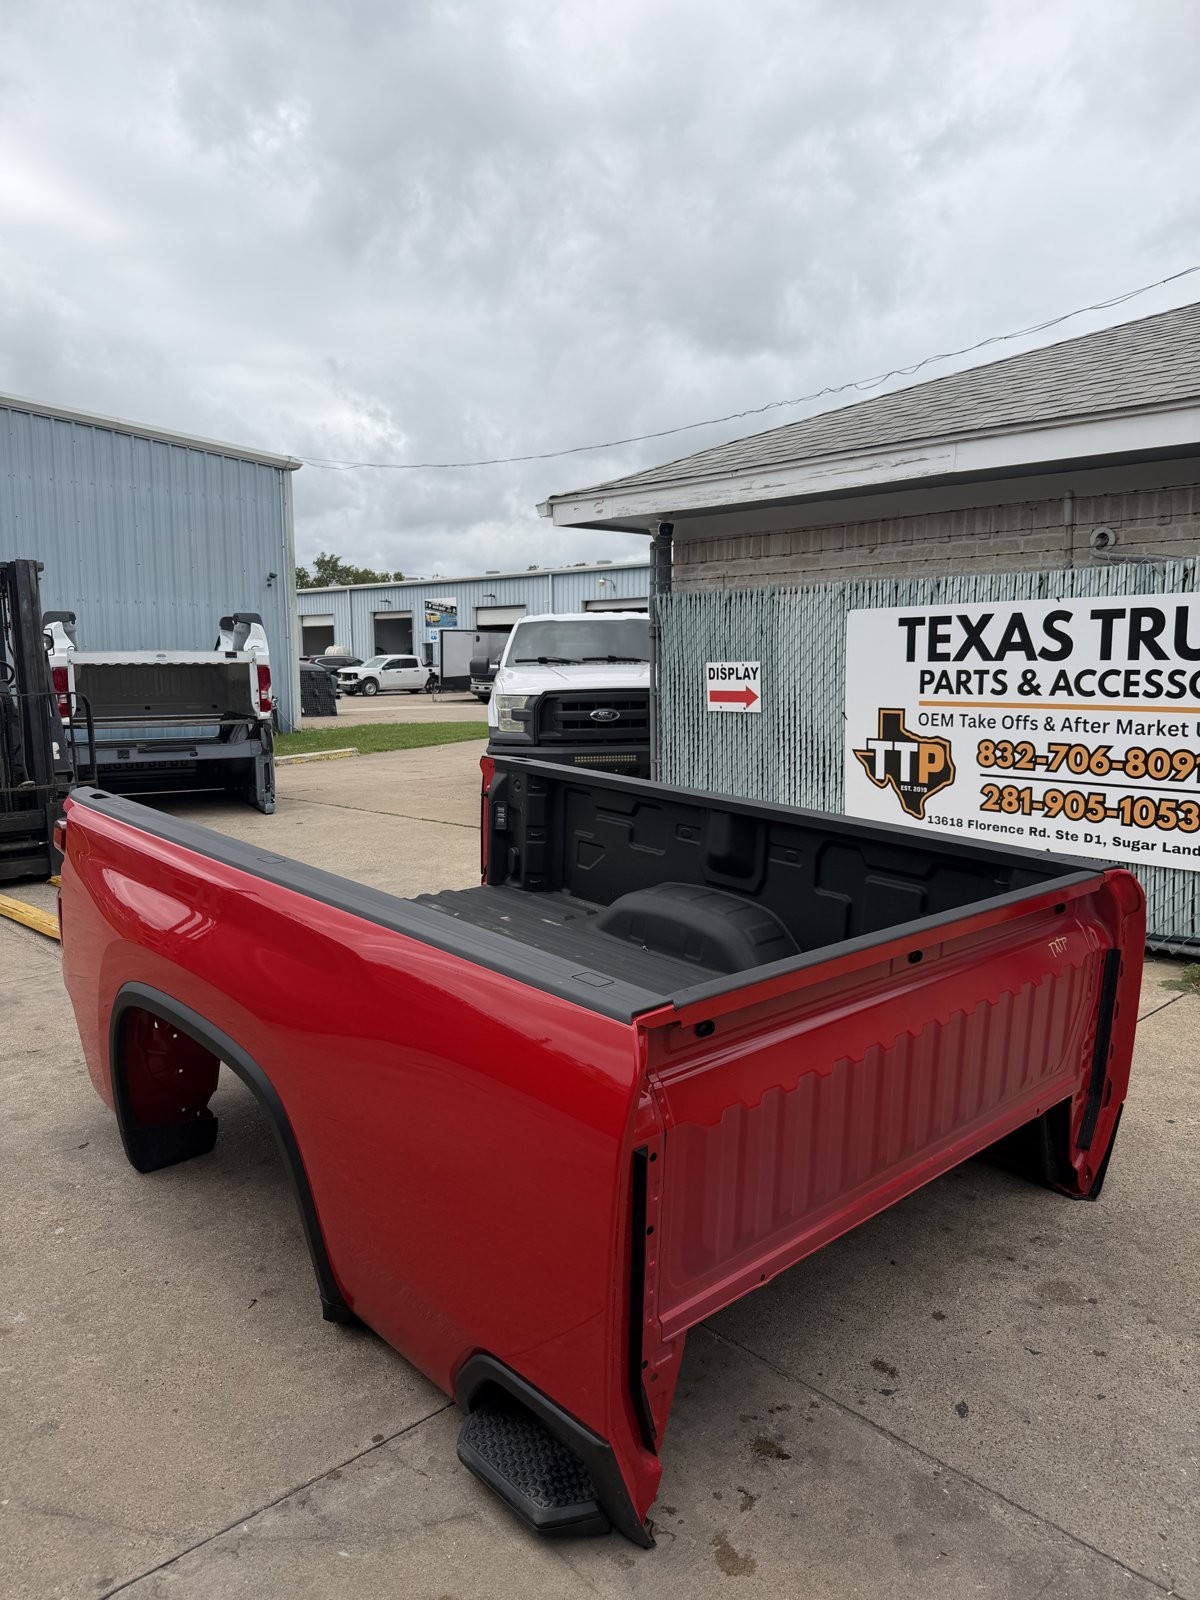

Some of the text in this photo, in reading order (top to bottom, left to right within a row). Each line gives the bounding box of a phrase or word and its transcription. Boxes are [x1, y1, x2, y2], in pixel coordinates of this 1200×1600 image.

[898, 605, 1200, 662] TEXAS TRU
[708, 667, 759, 680] DISPLAY
[919, 669, 1008, 696] PARTS
[1017, 668, 1043, 696] &
[918, 712, 954, 728] OEM
[959, 713, 997, 729] Take
[1001, 714, 1039, 731] Offs
[1043, 716, 1056, 732] &
[1060, 717, 1110, 734] After
[1116, 719, 1189, 738] Market
[867, 740, 945, 784] TTP
[979, 783, 1200, 834] 281-905-1053
[927, 815, 1200, 857] 13618 Florence Rd. Ste D1, Sugar Land
